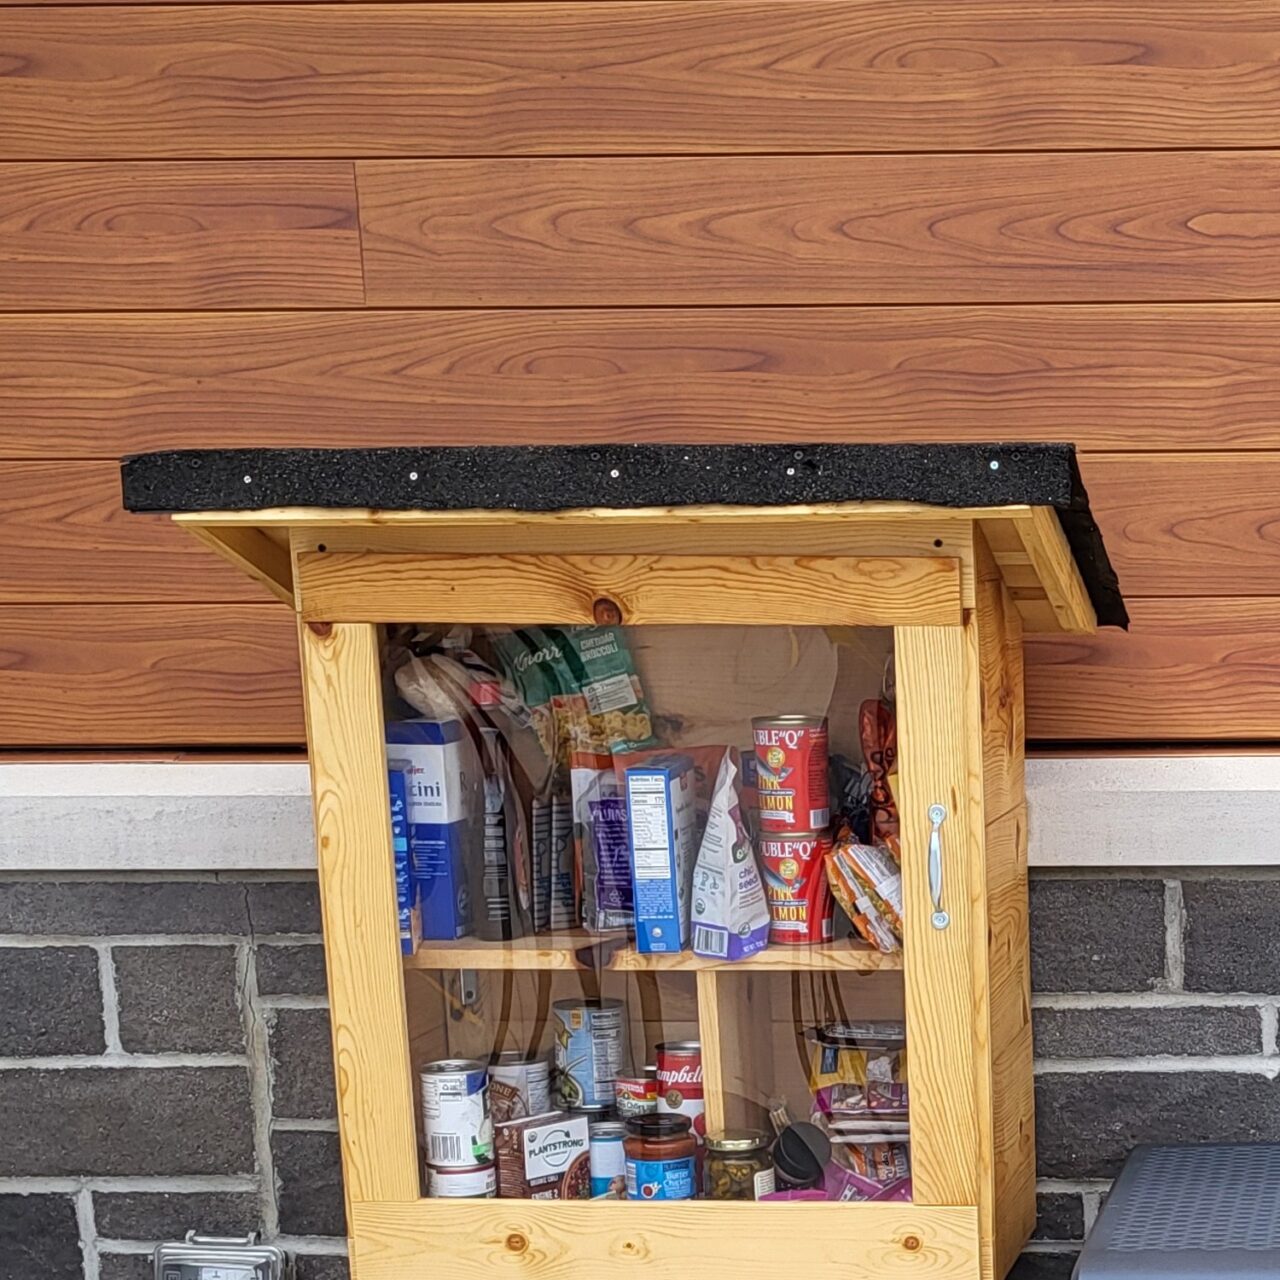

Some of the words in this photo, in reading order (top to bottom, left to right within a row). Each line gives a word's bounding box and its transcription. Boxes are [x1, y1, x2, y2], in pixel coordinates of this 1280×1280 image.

[579, 643, 618, 663] BROCCOLI
[753, 730, 780, 746] UBLE
[760, 841, 793, 857] UBLE
[772, 906, 807, 921] LMON
[528, 1138, 584, 1158] PLANTSTRONG
